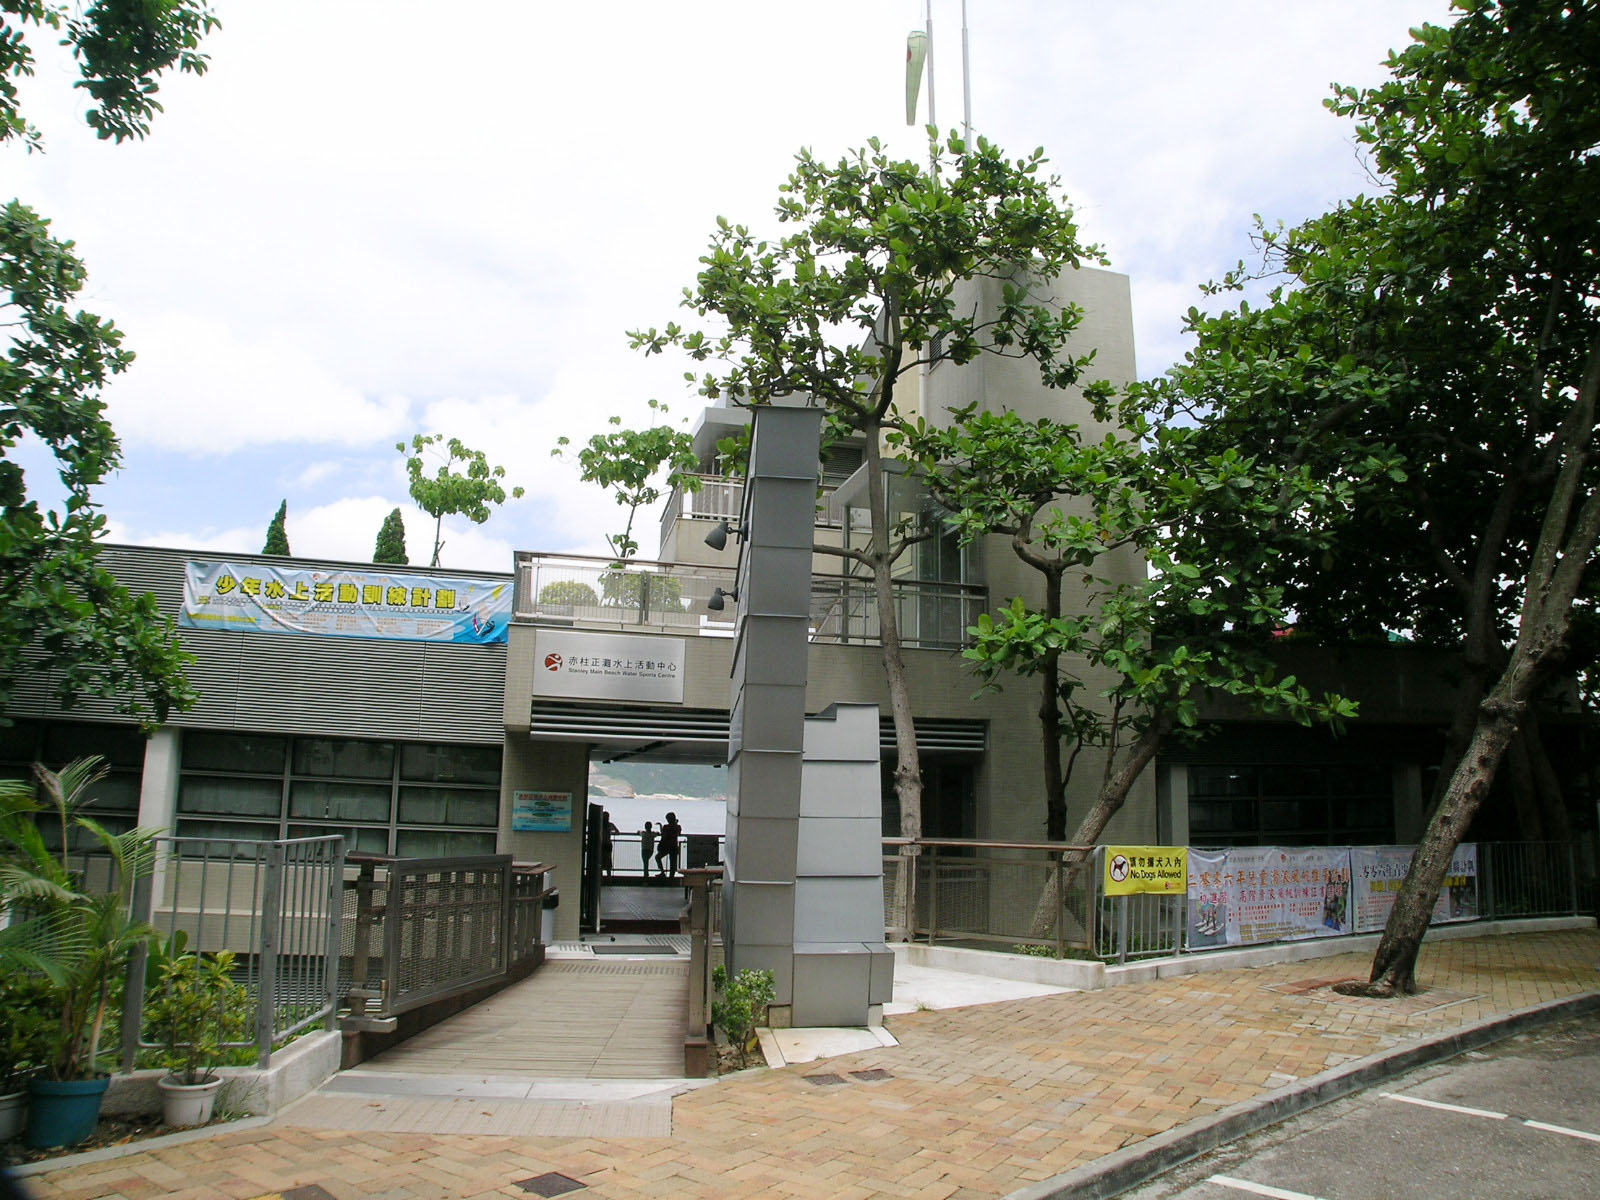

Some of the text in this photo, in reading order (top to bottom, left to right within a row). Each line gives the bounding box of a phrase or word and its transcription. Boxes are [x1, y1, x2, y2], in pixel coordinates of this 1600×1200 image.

[216, 575, 456, 608] 少年水上活動訓練計劃
[568, 656, 676, 672] 赤柱正灘水上活動中心
[568, 667, 588, 675] Stanley
[1130, 870, 1182, 880] No Dogs Allowed
